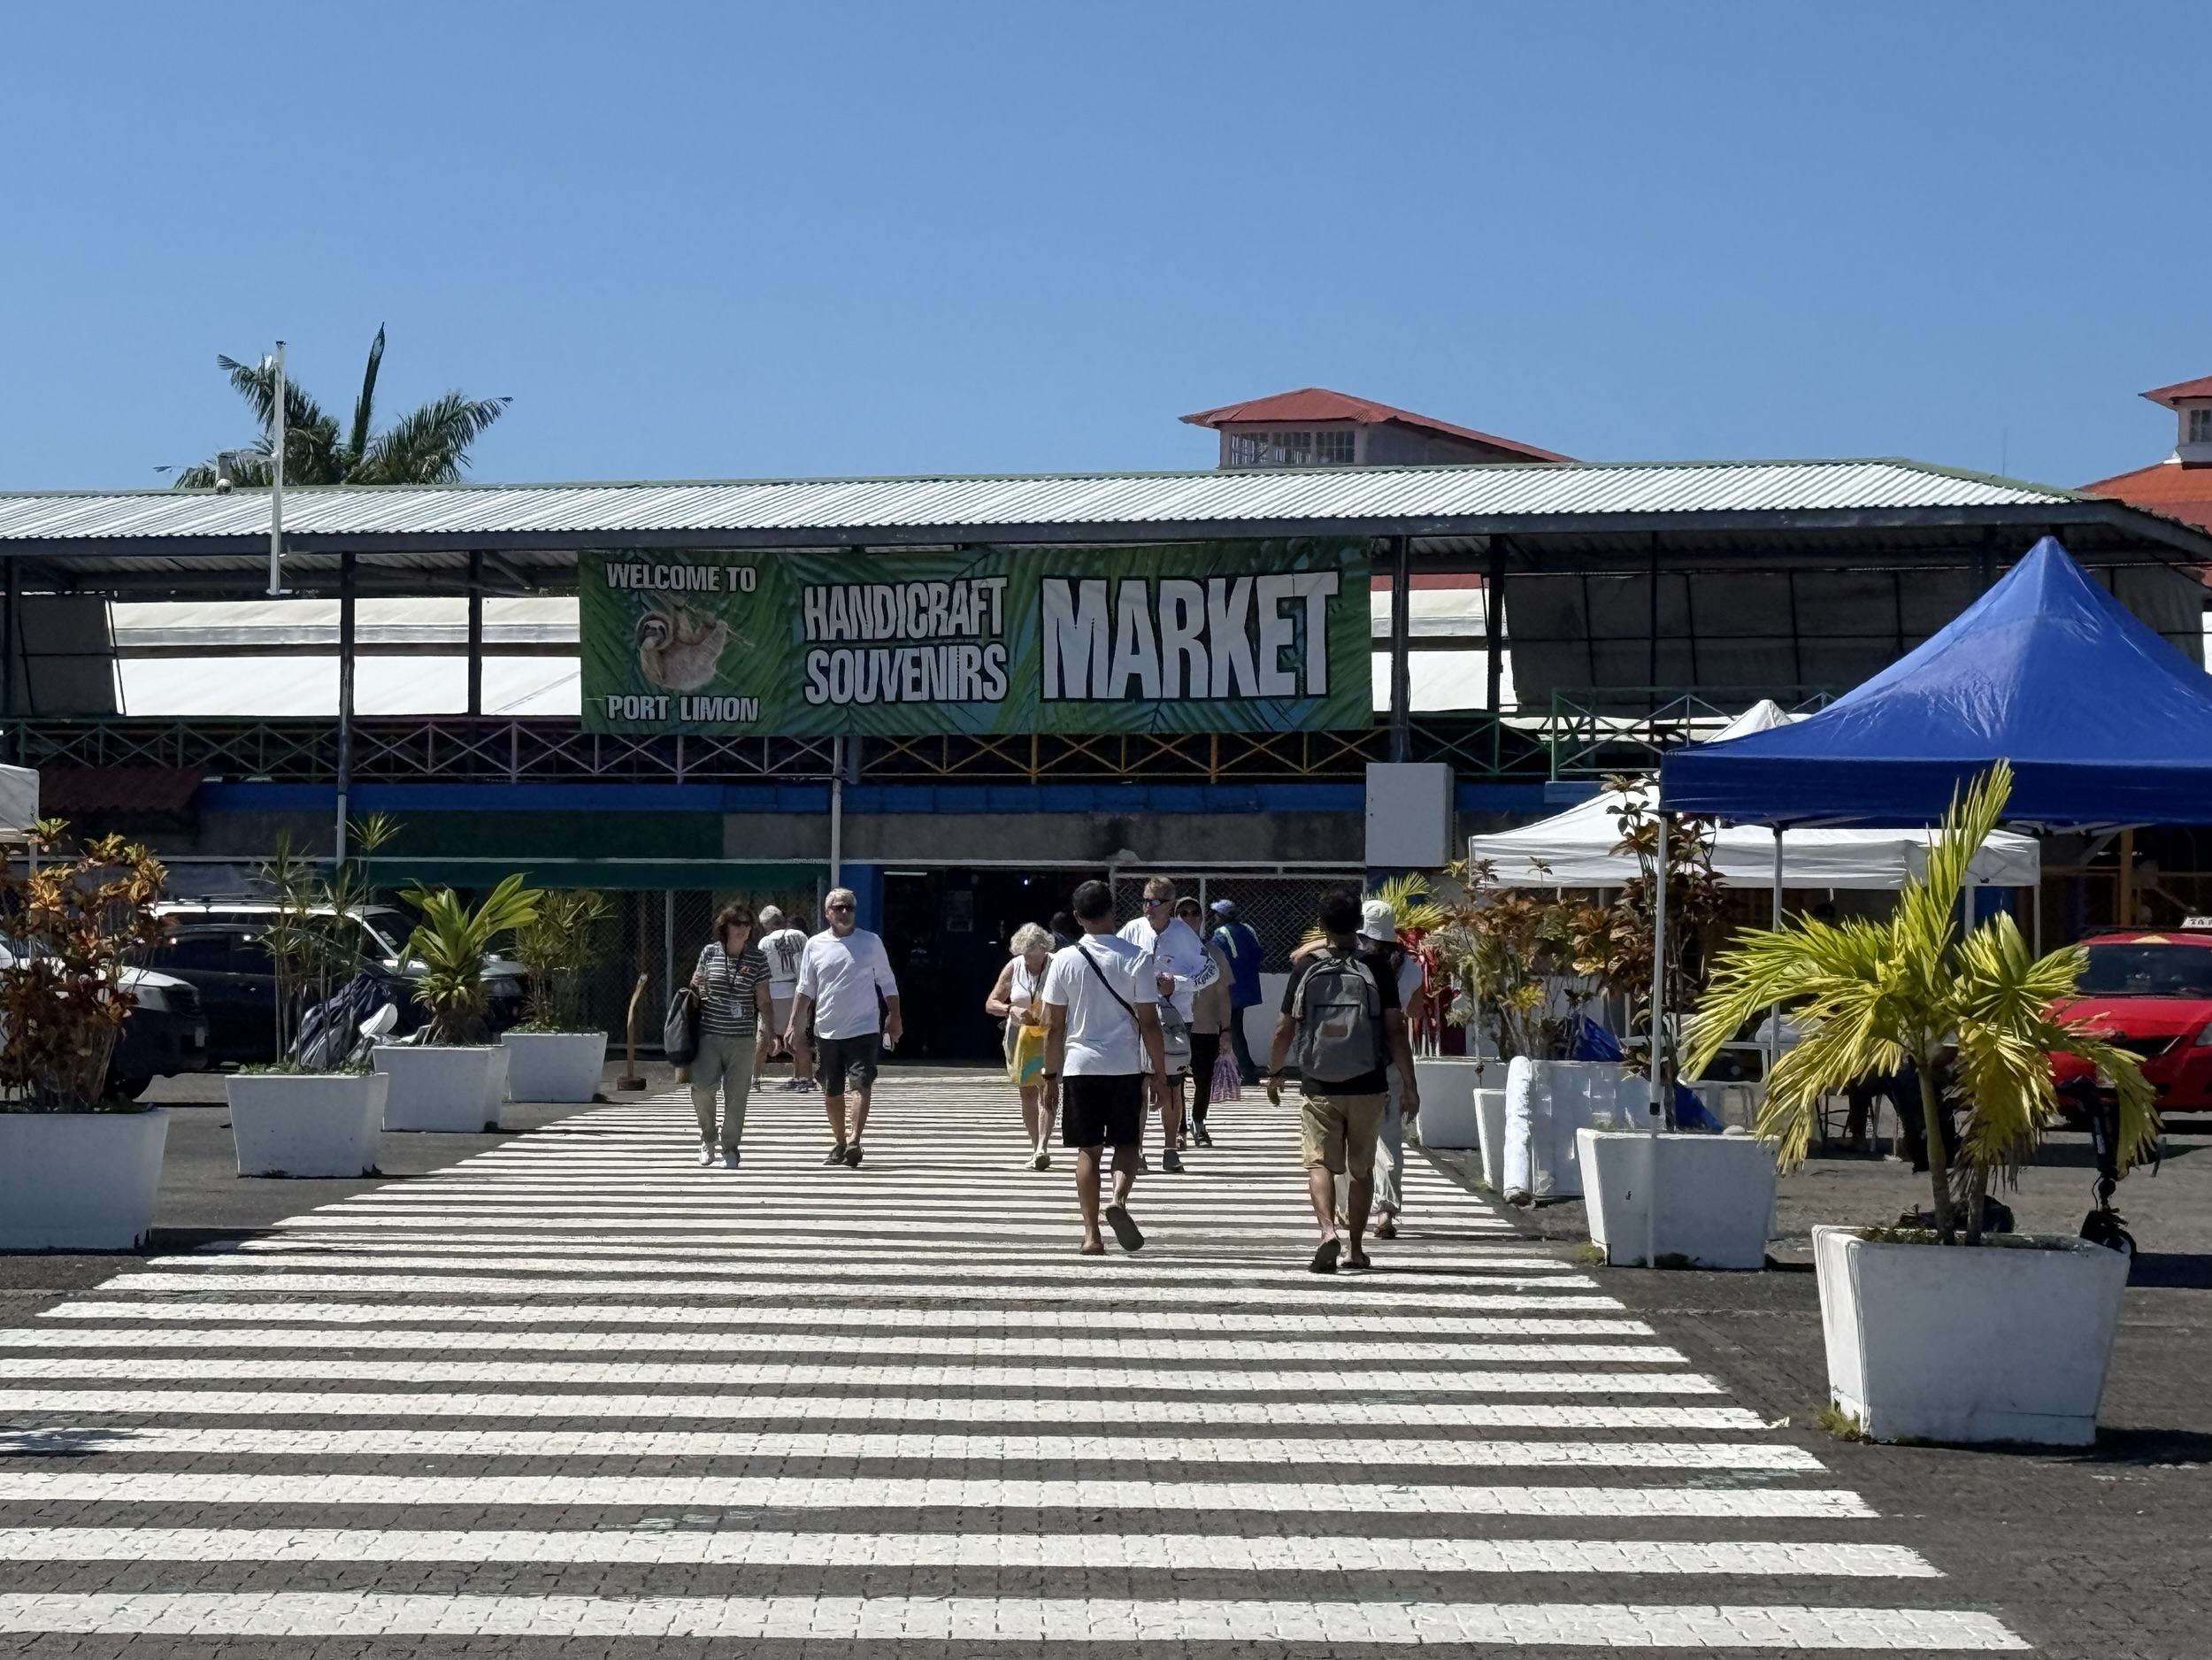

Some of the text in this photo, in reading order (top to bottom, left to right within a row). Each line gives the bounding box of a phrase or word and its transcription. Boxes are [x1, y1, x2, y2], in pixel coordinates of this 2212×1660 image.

[606, 562, 757, 592] WELCOME TO
[804, 577, 1008, 641] HANDICRAFT
[1042, 572, 1339, 699] MARKET
[804, 643, 1008, 704] SOUVENIRS
[608, 695, 759, 722] PORT LIMON
